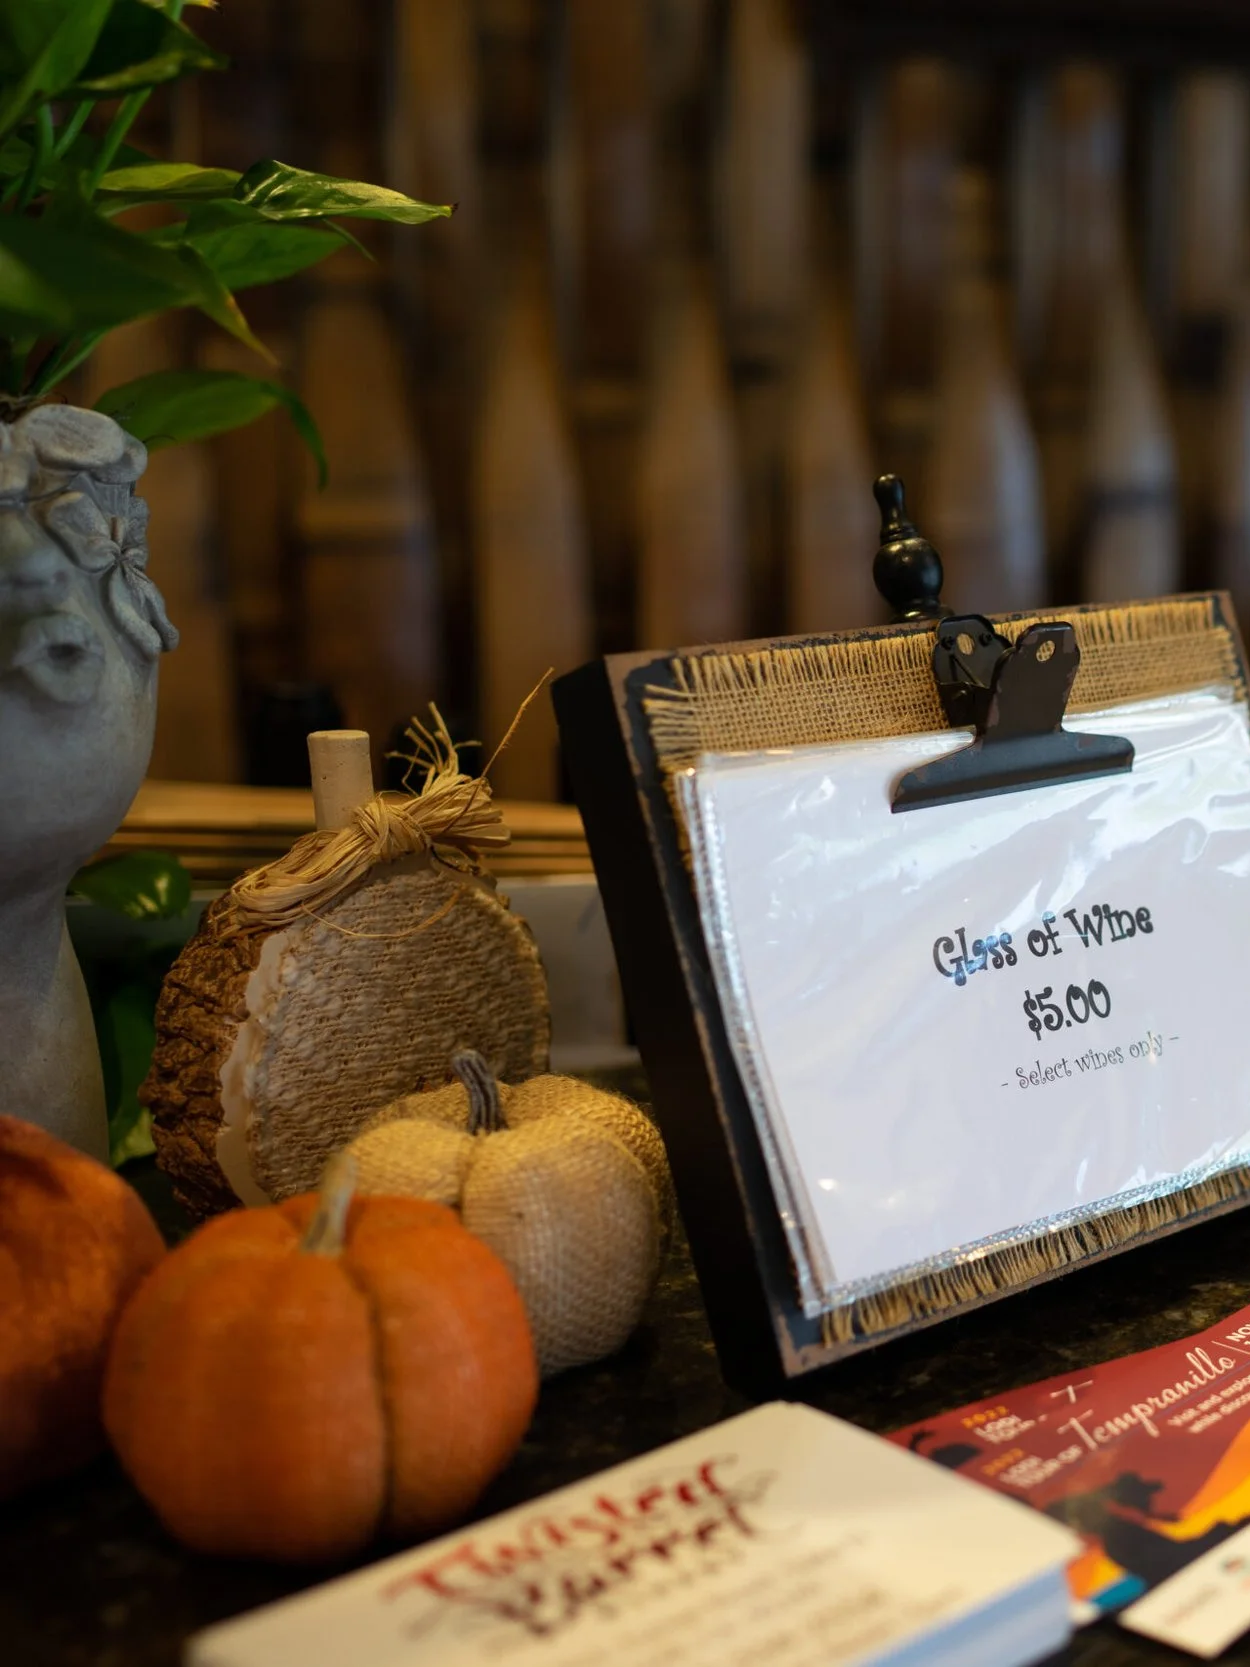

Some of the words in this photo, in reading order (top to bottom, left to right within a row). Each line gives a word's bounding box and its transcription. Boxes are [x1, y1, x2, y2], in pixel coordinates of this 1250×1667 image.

[933, 927, 1018, 986] Glass
[1027, 911, 1063, 957] of
[1063, 904, 1154, 949] Wine
[1023, 979, 1111, 1041] $5.00
[1015, 1060, 1072, 1089] Select
[1075, 1046, 1125, 1073] wines
[1129, 1032, 1163, 1058] only
[1057, 1346, 1236, 1452] Tempranillo
[1197, 1394, 1223, 1412] and
